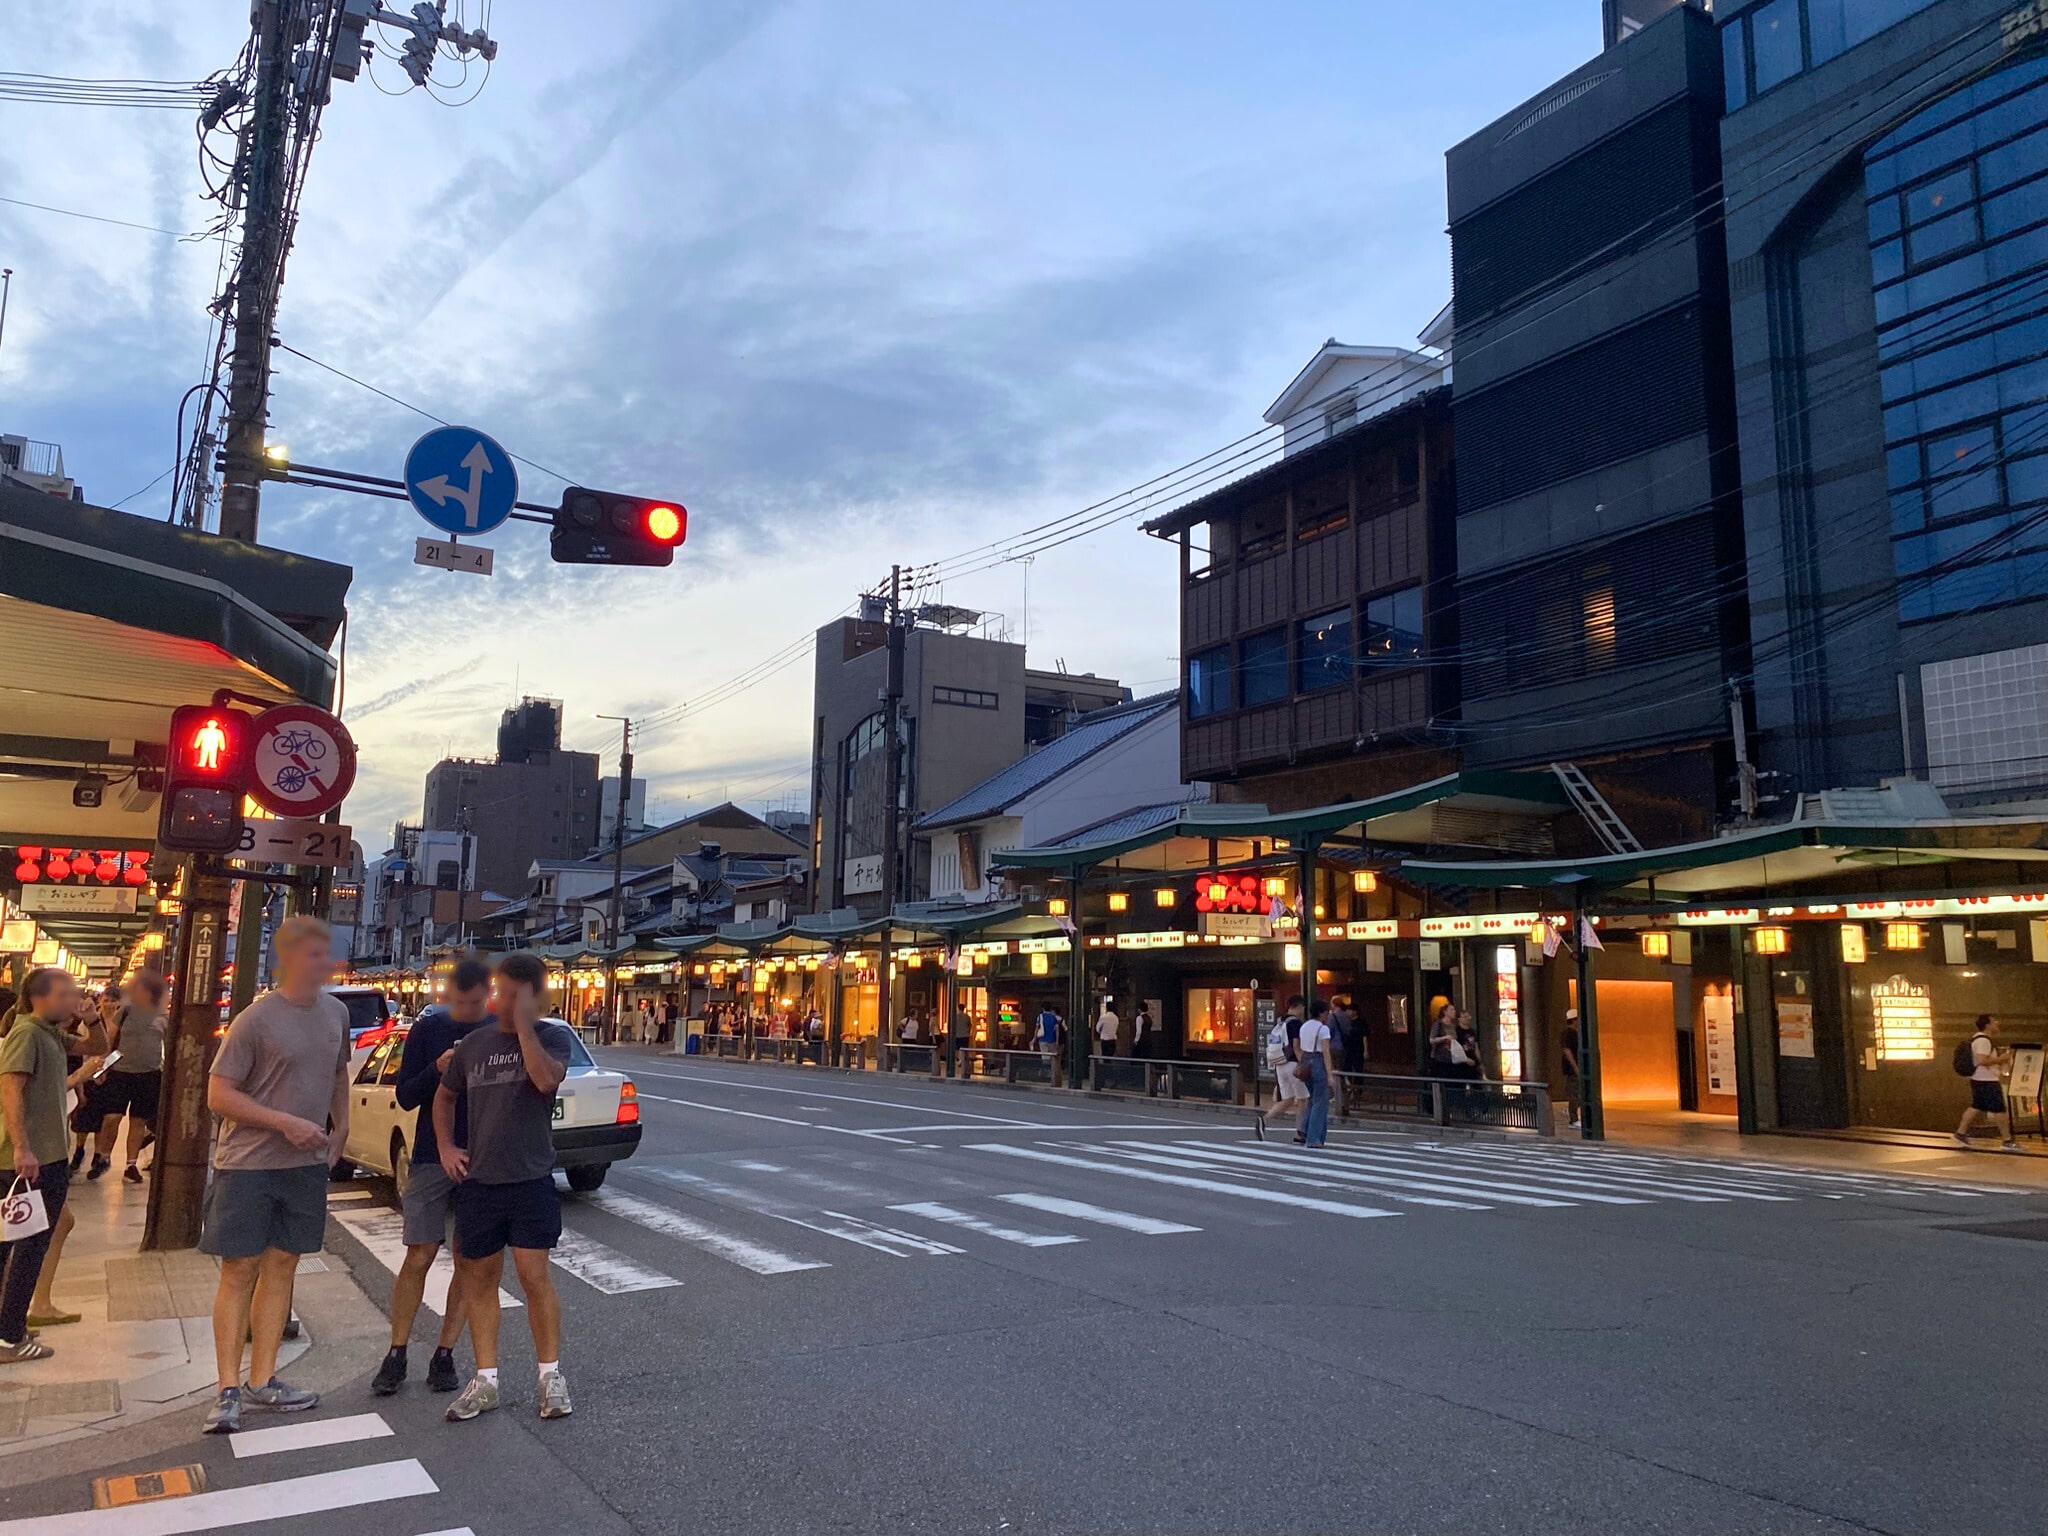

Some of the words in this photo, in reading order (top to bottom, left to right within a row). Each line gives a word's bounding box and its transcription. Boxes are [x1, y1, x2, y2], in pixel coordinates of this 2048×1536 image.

[426, 546, 440, 560] 21
[475, 554, 483, 567] 4
[304, 831, 342, 858] 21
[488, 1052, 519, 1066] ZÜRICH
